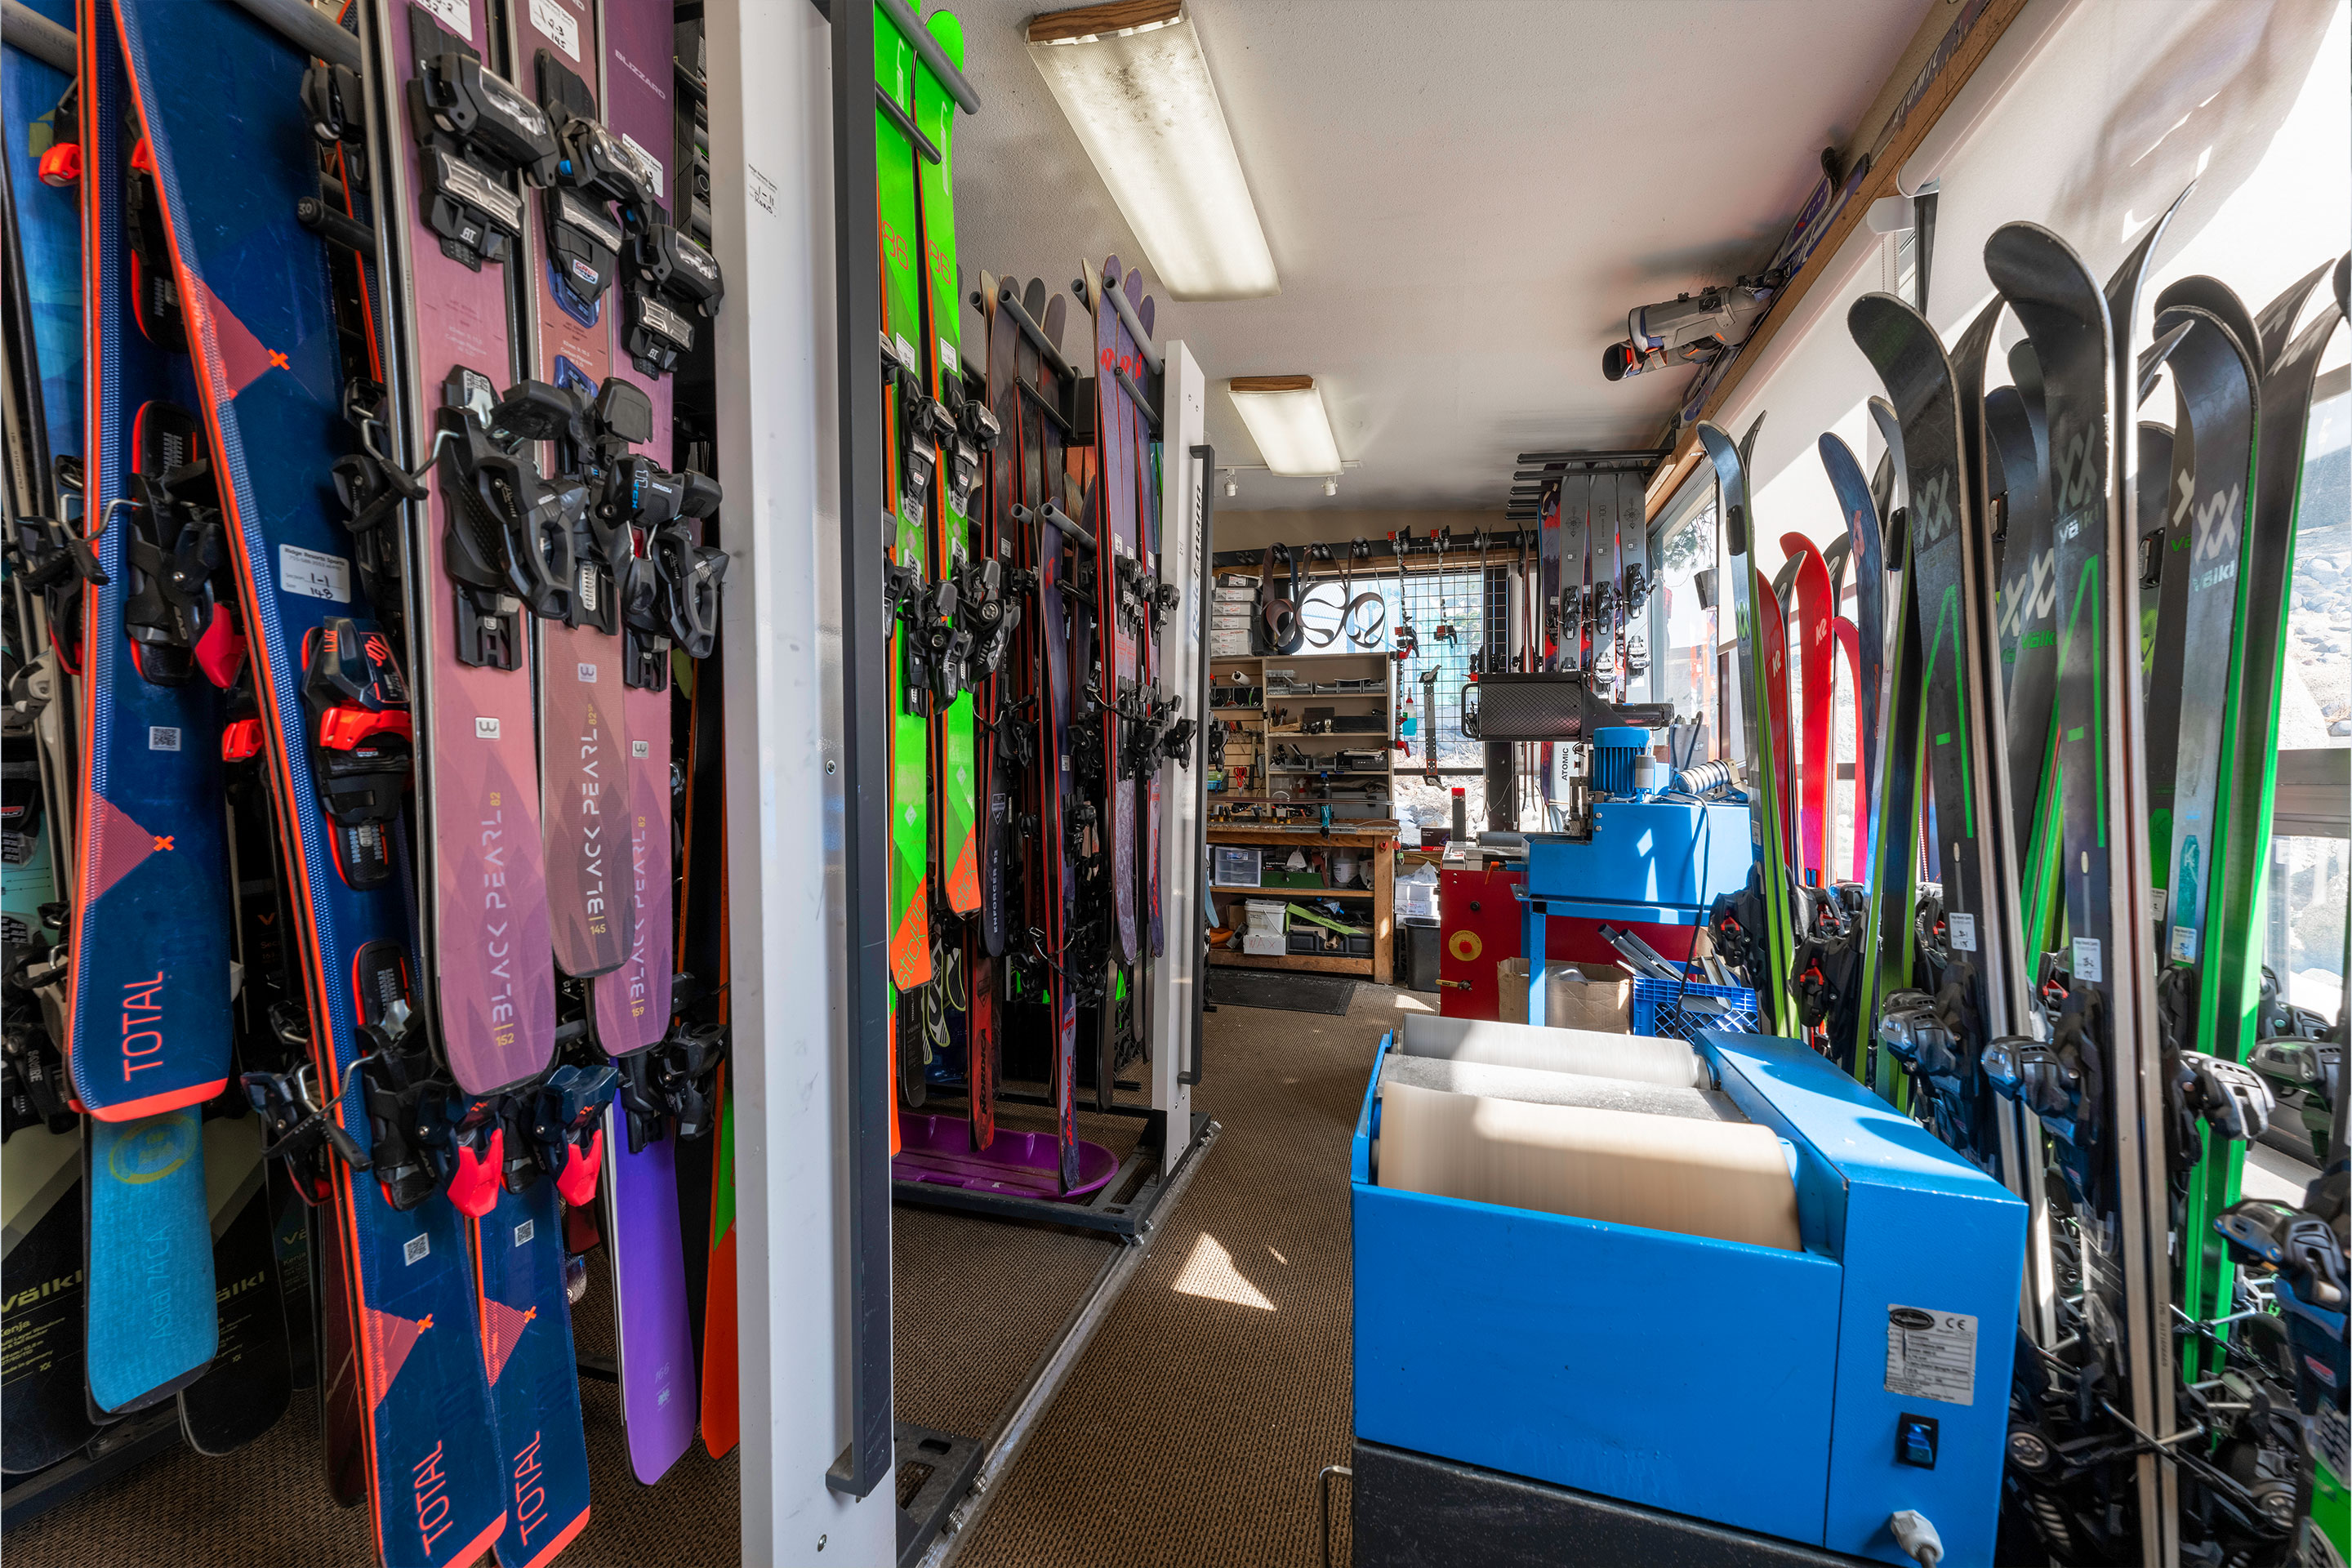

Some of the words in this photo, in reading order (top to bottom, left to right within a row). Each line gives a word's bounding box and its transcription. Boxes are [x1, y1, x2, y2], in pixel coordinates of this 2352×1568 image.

[615, 49, 666, 100] BLIZZARD
[1891, 44, 1940, 128] ATOMIC
[298, 202, 313, 216] 30
[883, 220, 908, 270] 86
[929, 239, 951, 285] 86
[284, 547, 302, 556] Ridge
[310, 587, 333, 599] 148
[311, 572, 329, 588] 1-1
[365, 635, 391, 667] JOY
[1815, 618, 1827, 646] K2
[1773, 649, 1781, 678] K2
[581, 728, 599, 815] PEARL
[490, 791, 501, 807] 82
[638, 816, 646, 828] 82
[481, 810, 508, 909] PEARL
[583, 826, 604, 915] BLACK
[634, 829, 646, 908] PEARL
[907, 895, 927, 926] rip
[956, 862, 977, 912] stick
[590, 924, 606, 934] 145
[1249, 938, 1275, 948] WAX
[488, 920, 513, 1022] BLACK
[630, 917, 645, 999] BLACK
[898, 922, 927, 990] stick
[123, 971, 163, 1082] TOTAL
[631, 1006, 644, 1017] 159
[496, 1032, 514, 1047] 152
[978, 1029, 987, 1115] NORDICA
[1065, 1055, 1073, 1146] NORDICA
[216, 1270, 265, 1303] ölkl
[413, 1440, 453, 1557] TOTAL
[514, 1431, 548, 1546] TOTAL
